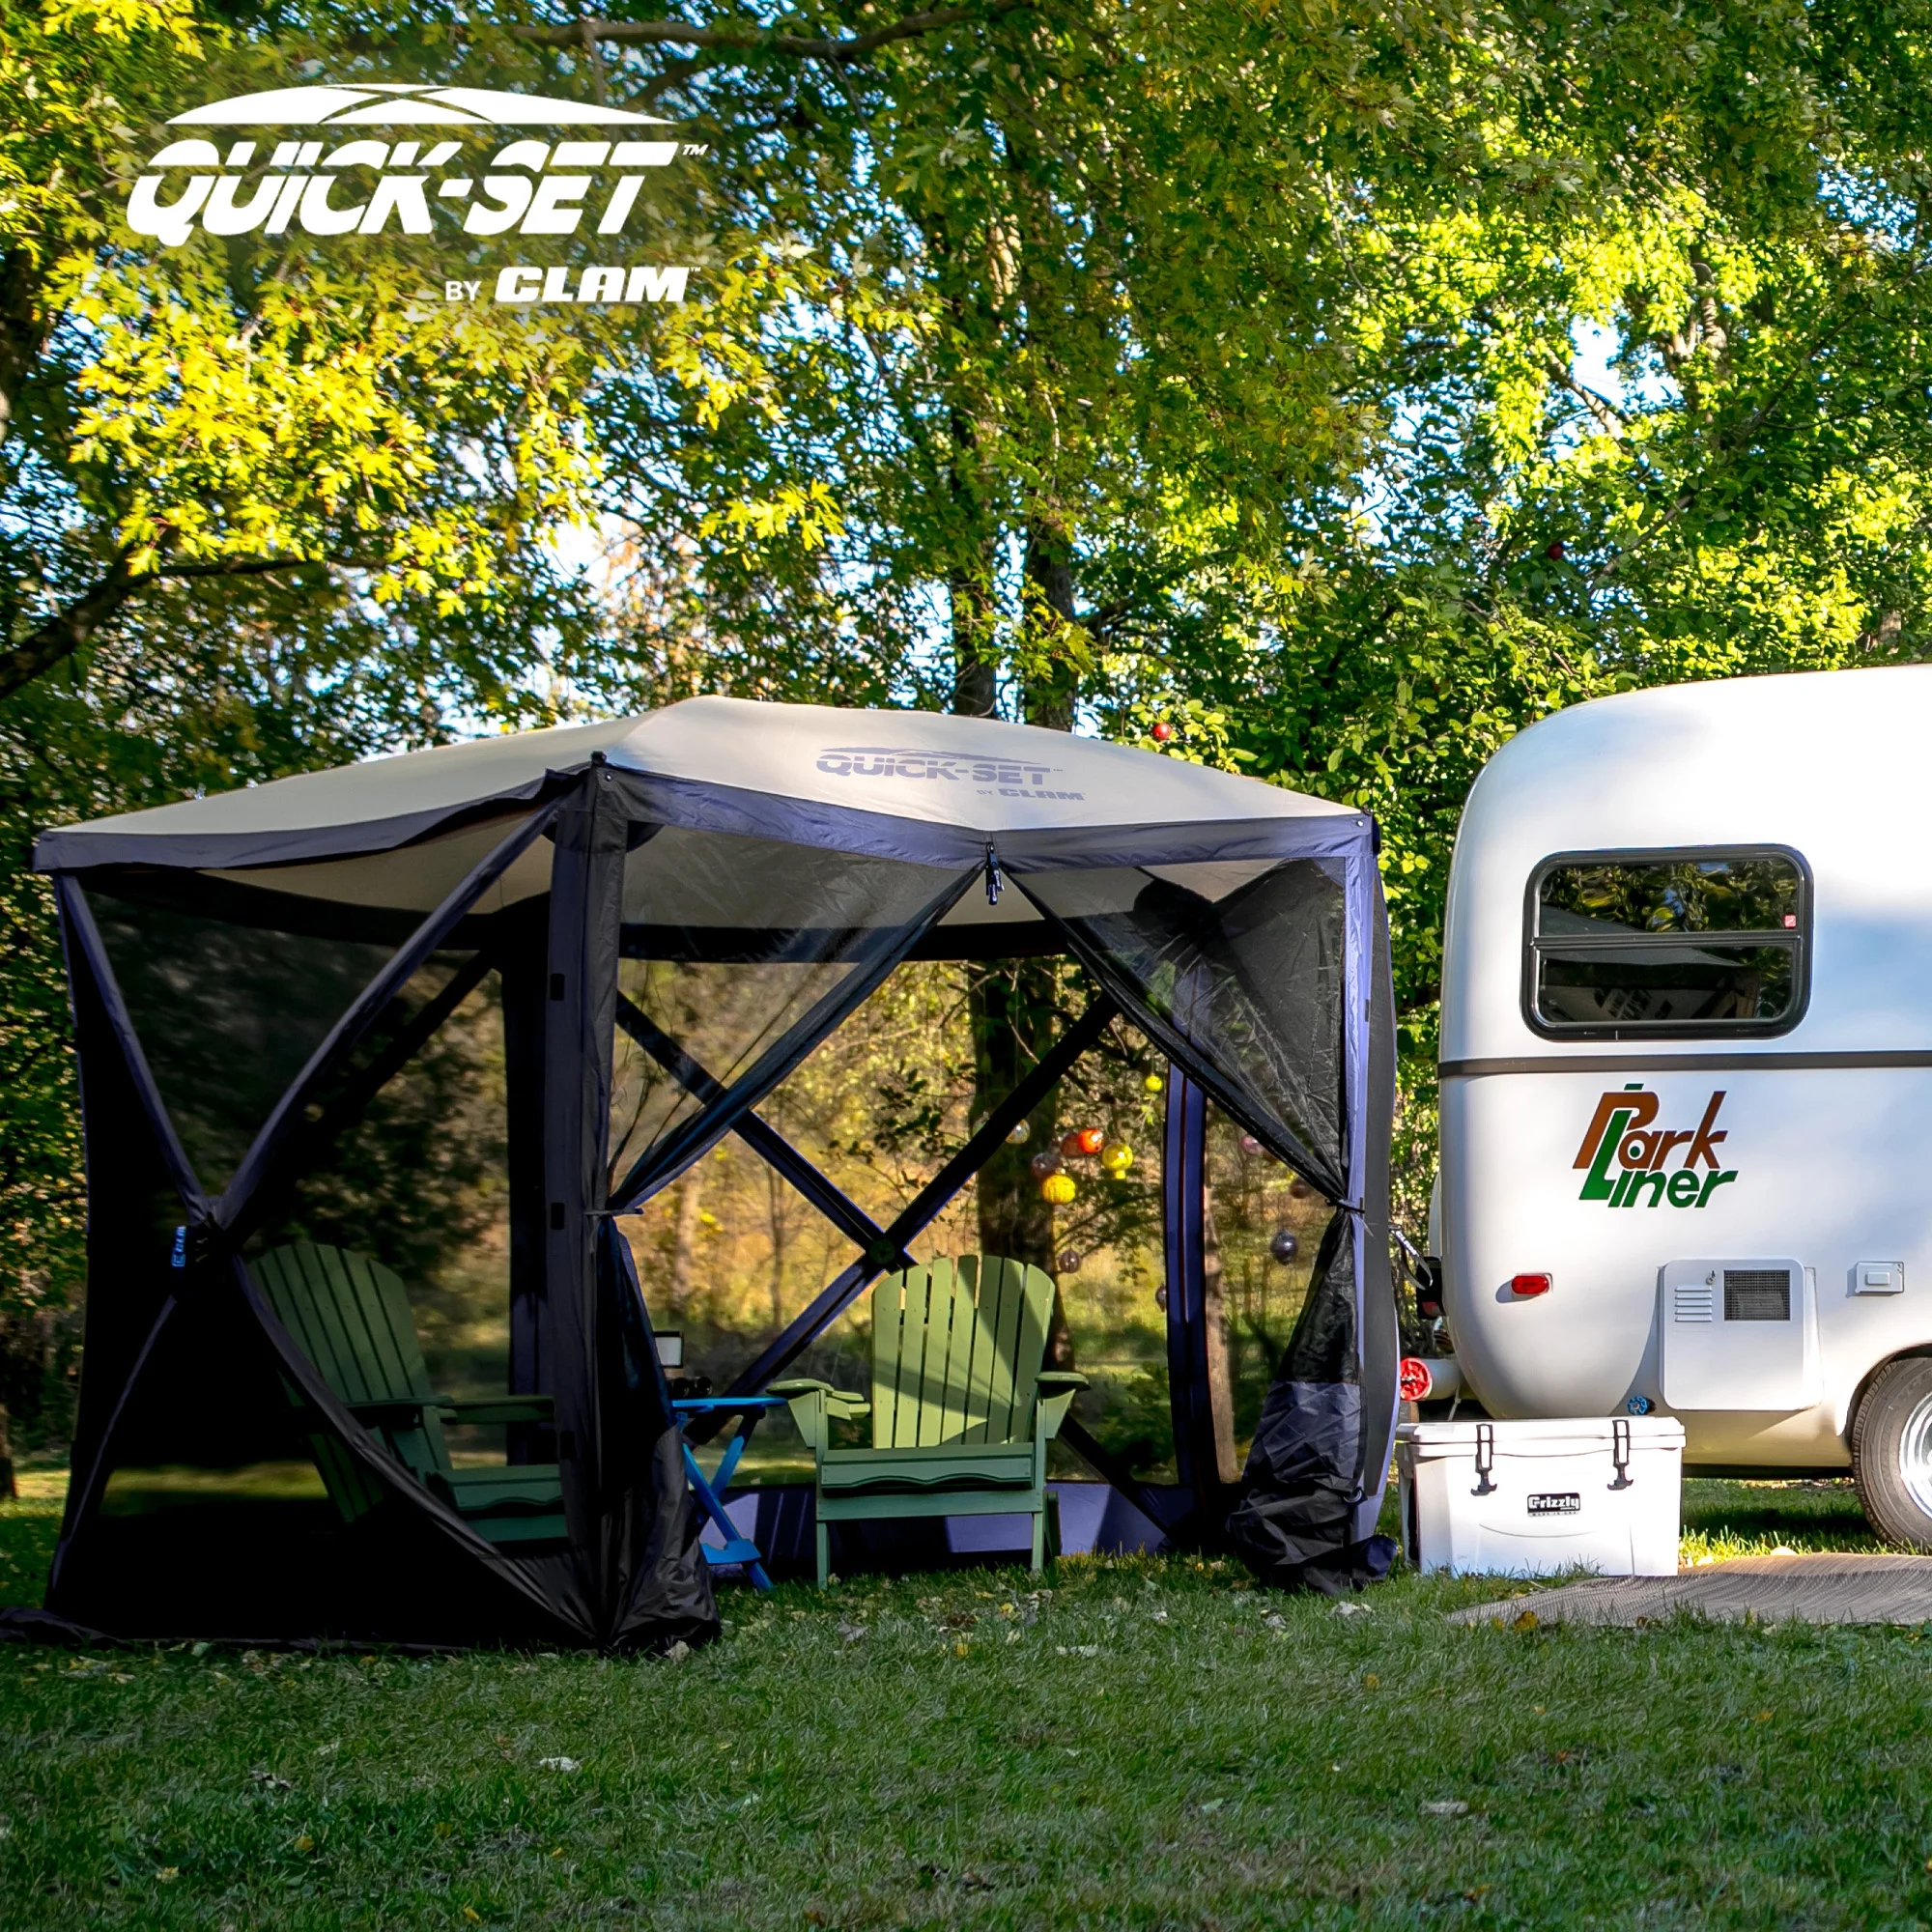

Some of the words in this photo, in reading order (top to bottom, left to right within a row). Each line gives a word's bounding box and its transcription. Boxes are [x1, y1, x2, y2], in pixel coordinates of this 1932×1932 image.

[816, 754, 1051, 785] QUICK-SET
[998, 788, 1085, 801] CLAM
[1573, 1091, 1728, 1173] Park
[1578, 1110, 1739, 1208] Liner
[1528, 1495, 1579, 1509] Grizzly
